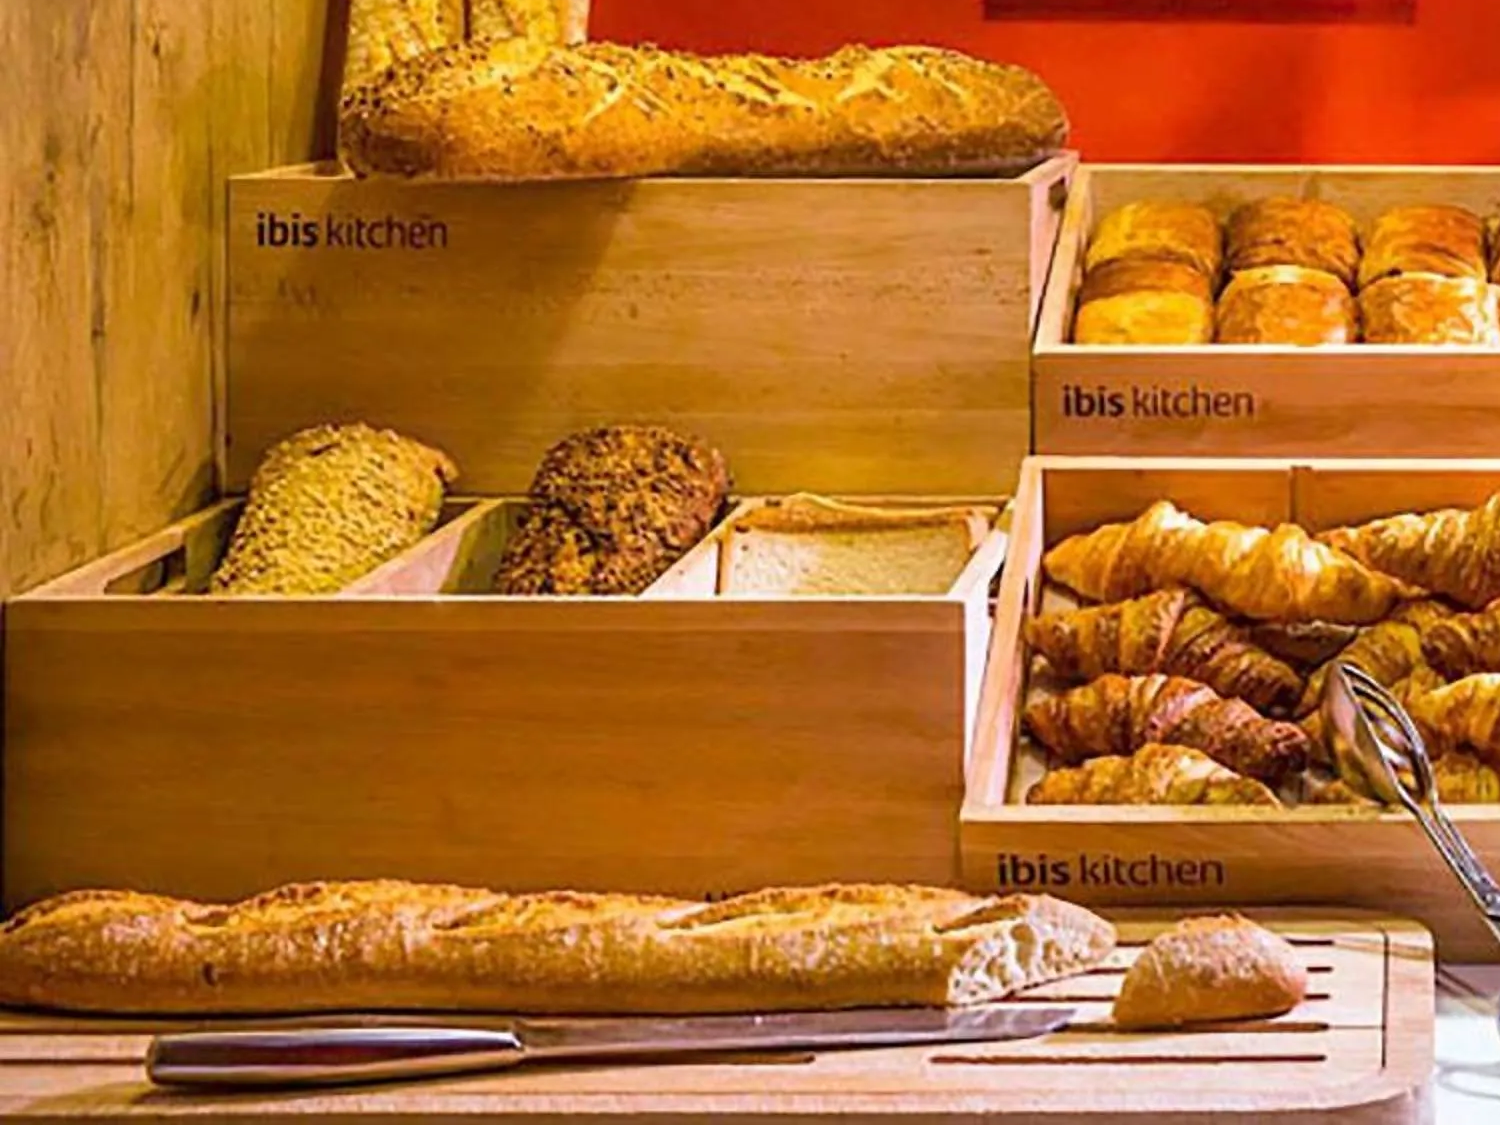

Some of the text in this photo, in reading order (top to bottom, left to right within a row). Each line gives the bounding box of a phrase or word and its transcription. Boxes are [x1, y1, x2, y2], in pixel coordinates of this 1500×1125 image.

[256, 211, 449, 250] ibis kitchen
[1062, 383, 1255, 418] ibis kitchen
[997, 853, 1225, 887] ibis kitchen
